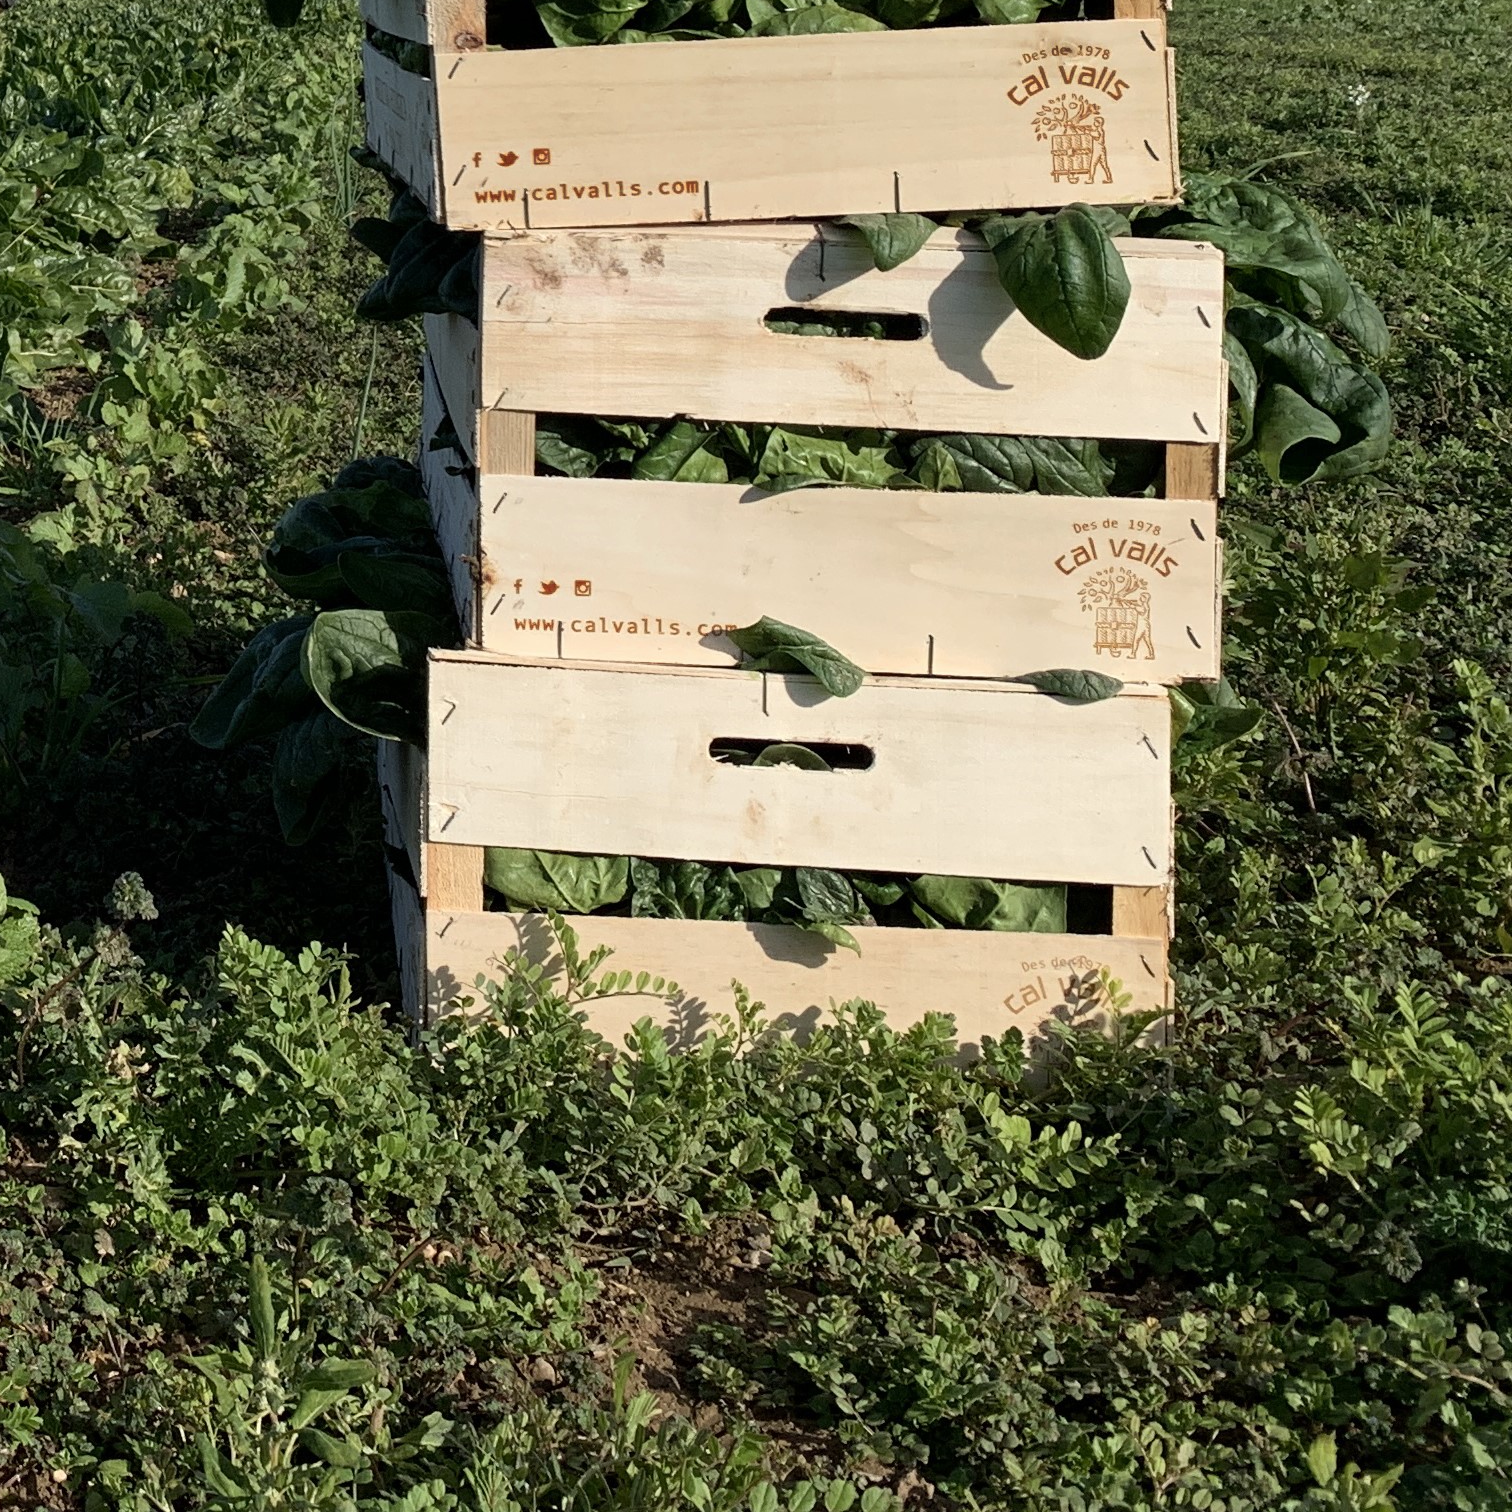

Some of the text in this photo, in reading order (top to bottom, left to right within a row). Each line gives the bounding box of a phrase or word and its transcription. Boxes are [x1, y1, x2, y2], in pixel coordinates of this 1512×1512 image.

[1022, 45, 1111, 64] Des de 1978
[1007, 65, 1130, 106] cal valls
[474, 180, 699, 204] www.calvalls.com
[1073, 518, 1162, 536] Des de 1978
[1054, 537, 1179, 577] cal valls
[1021, 959, 1046, 972] Des
[1004, 976, 1047, 1014] cal
